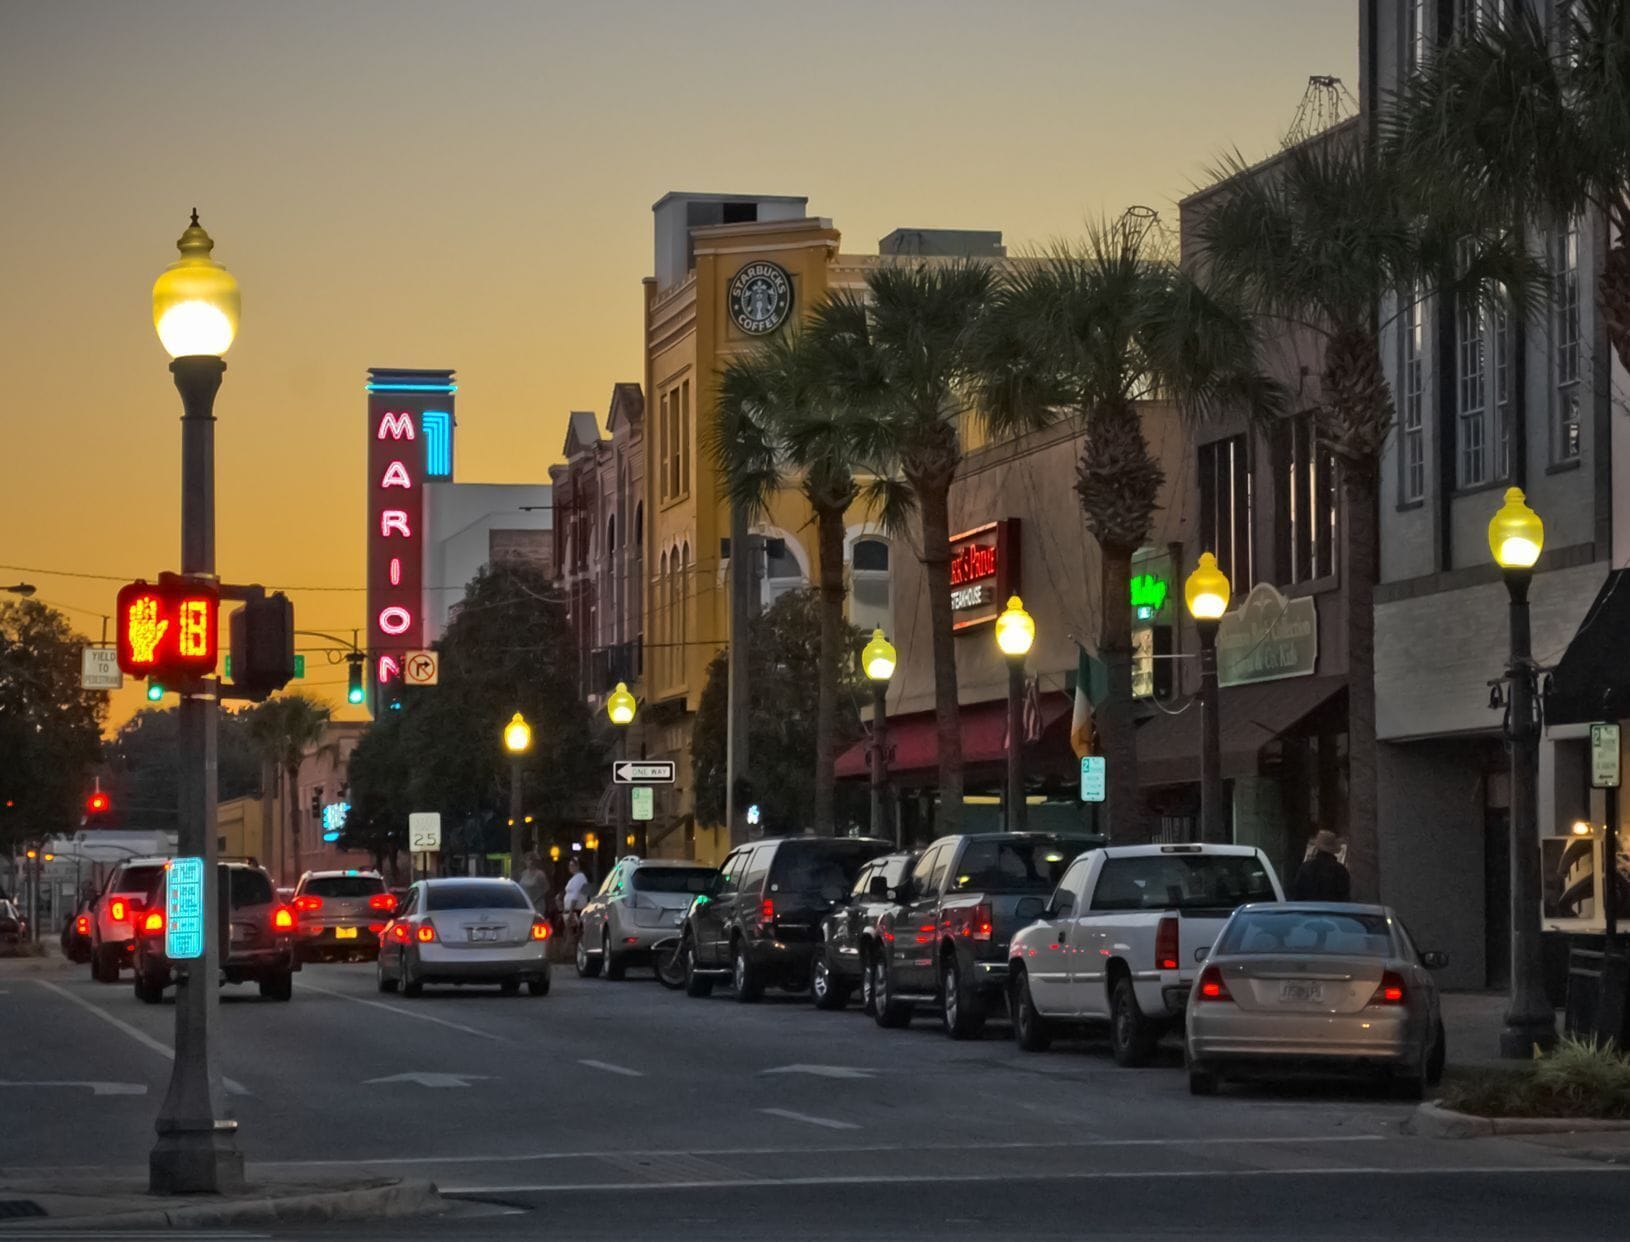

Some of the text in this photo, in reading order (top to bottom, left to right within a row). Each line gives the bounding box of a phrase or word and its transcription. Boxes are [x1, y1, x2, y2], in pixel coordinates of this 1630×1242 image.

[733, 266, 786, 297] STARBUCKS
[738, 313, 779, 331] COFFEE
[378, 412, 414, 683] MARION
[951, 585, 982, 610] TEAKHOUSE
[179, 601, 207, 656] 18
[92, 651, 116, 661] YIELD
[99, 663, 109, 672] TO
[414, 833, 437, 847] 25
